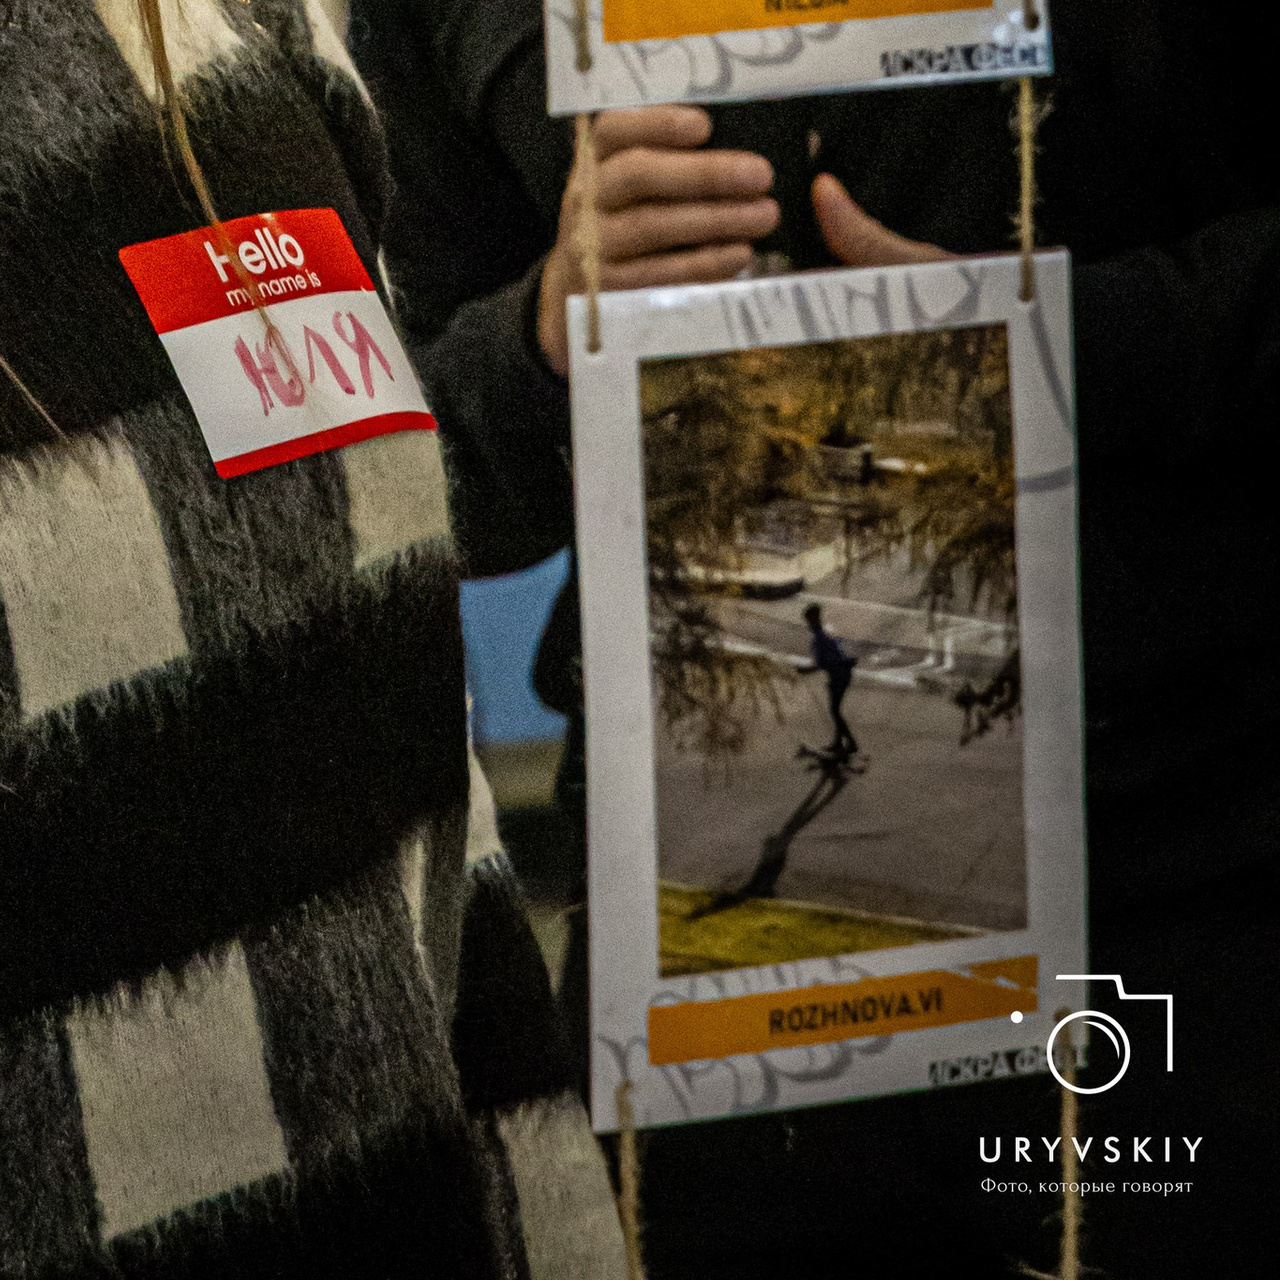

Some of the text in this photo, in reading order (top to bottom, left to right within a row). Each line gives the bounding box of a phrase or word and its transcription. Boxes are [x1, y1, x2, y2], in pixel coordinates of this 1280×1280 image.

[258, 273, 308, 300] name
[303, 268, 322, 288] is
[769, 990, 945, 1037] ROZHNOVA.VI
